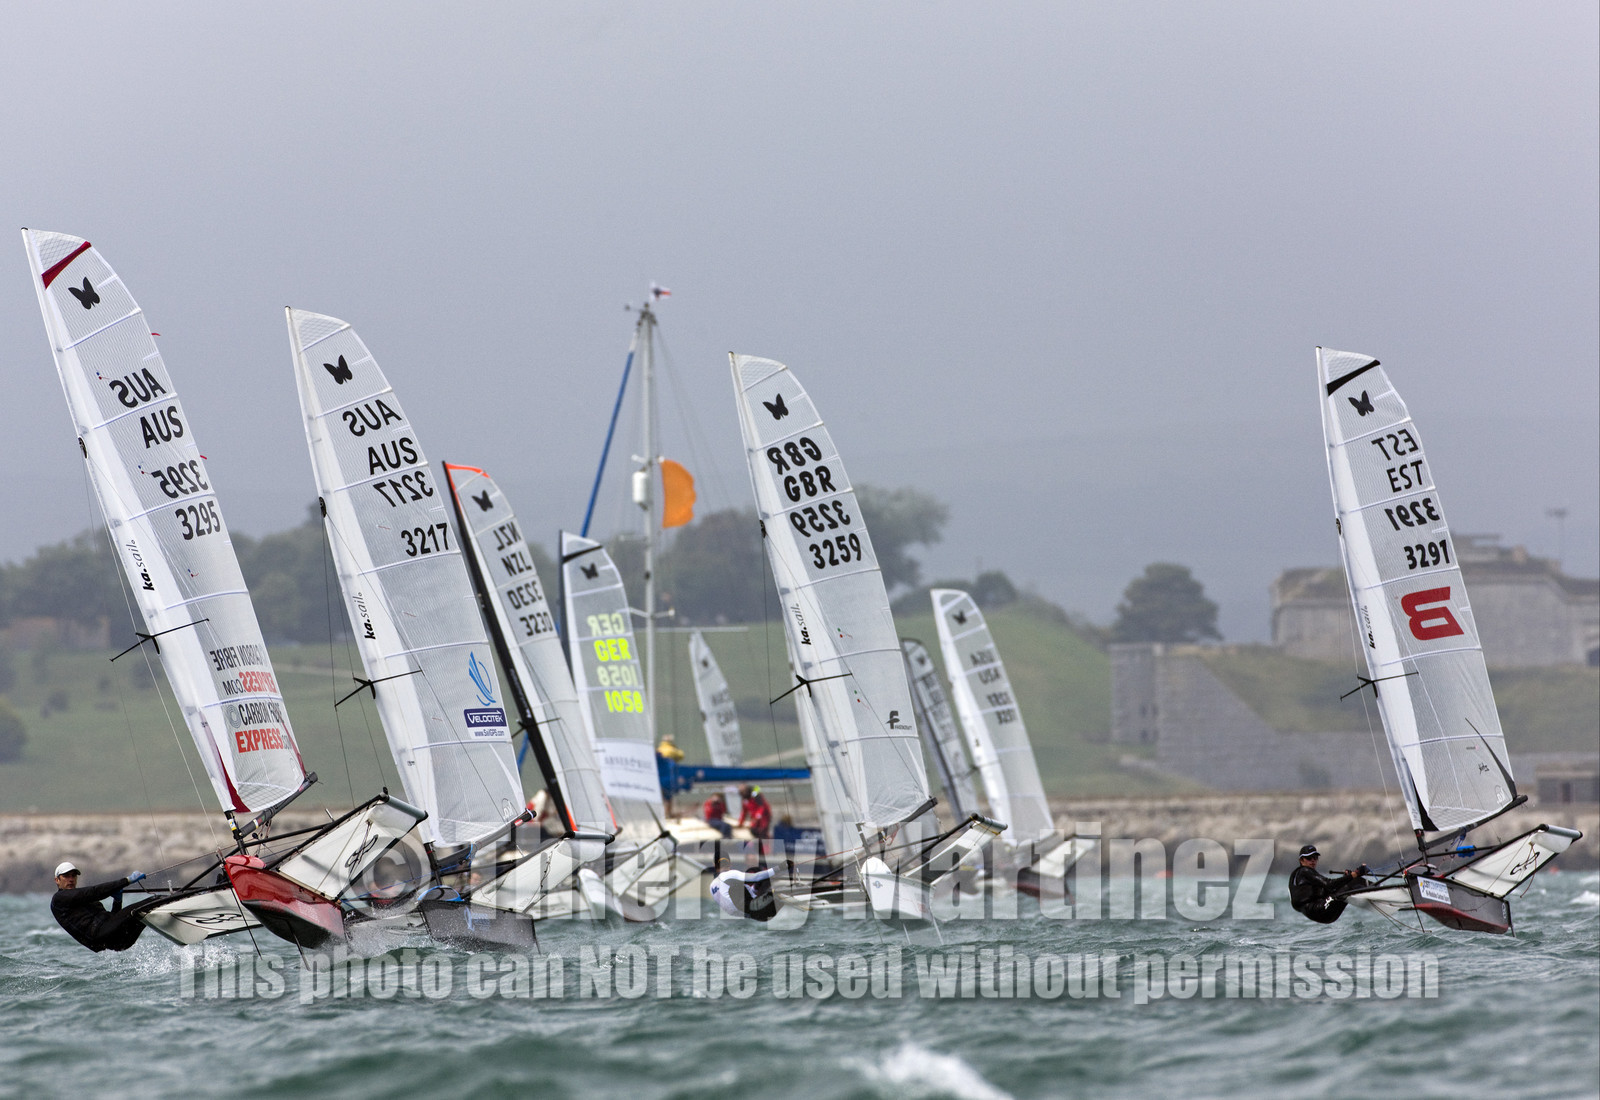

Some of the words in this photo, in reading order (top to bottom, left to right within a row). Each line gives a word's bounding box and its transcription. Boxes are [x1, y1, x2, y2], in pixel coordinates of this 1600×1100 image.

[140, 406, 184, 449] AUS
[367, 437, 418, 475] AUS
[784, 465, 837, 502] GBR
[1386, 460, 1423, 493] EST
[175, 501, 221, 541] 3295
[401, 523, 449, 557] 3217
[809, 533, 861, 569] 3259
[1404, 539, 1450, 570] 3291
[501, 551, 532, 577] NZL
[519, 612, 554, 637] 3230
[594, 638, 632, 662] GER
[604, 691, 644, 713] 1058
